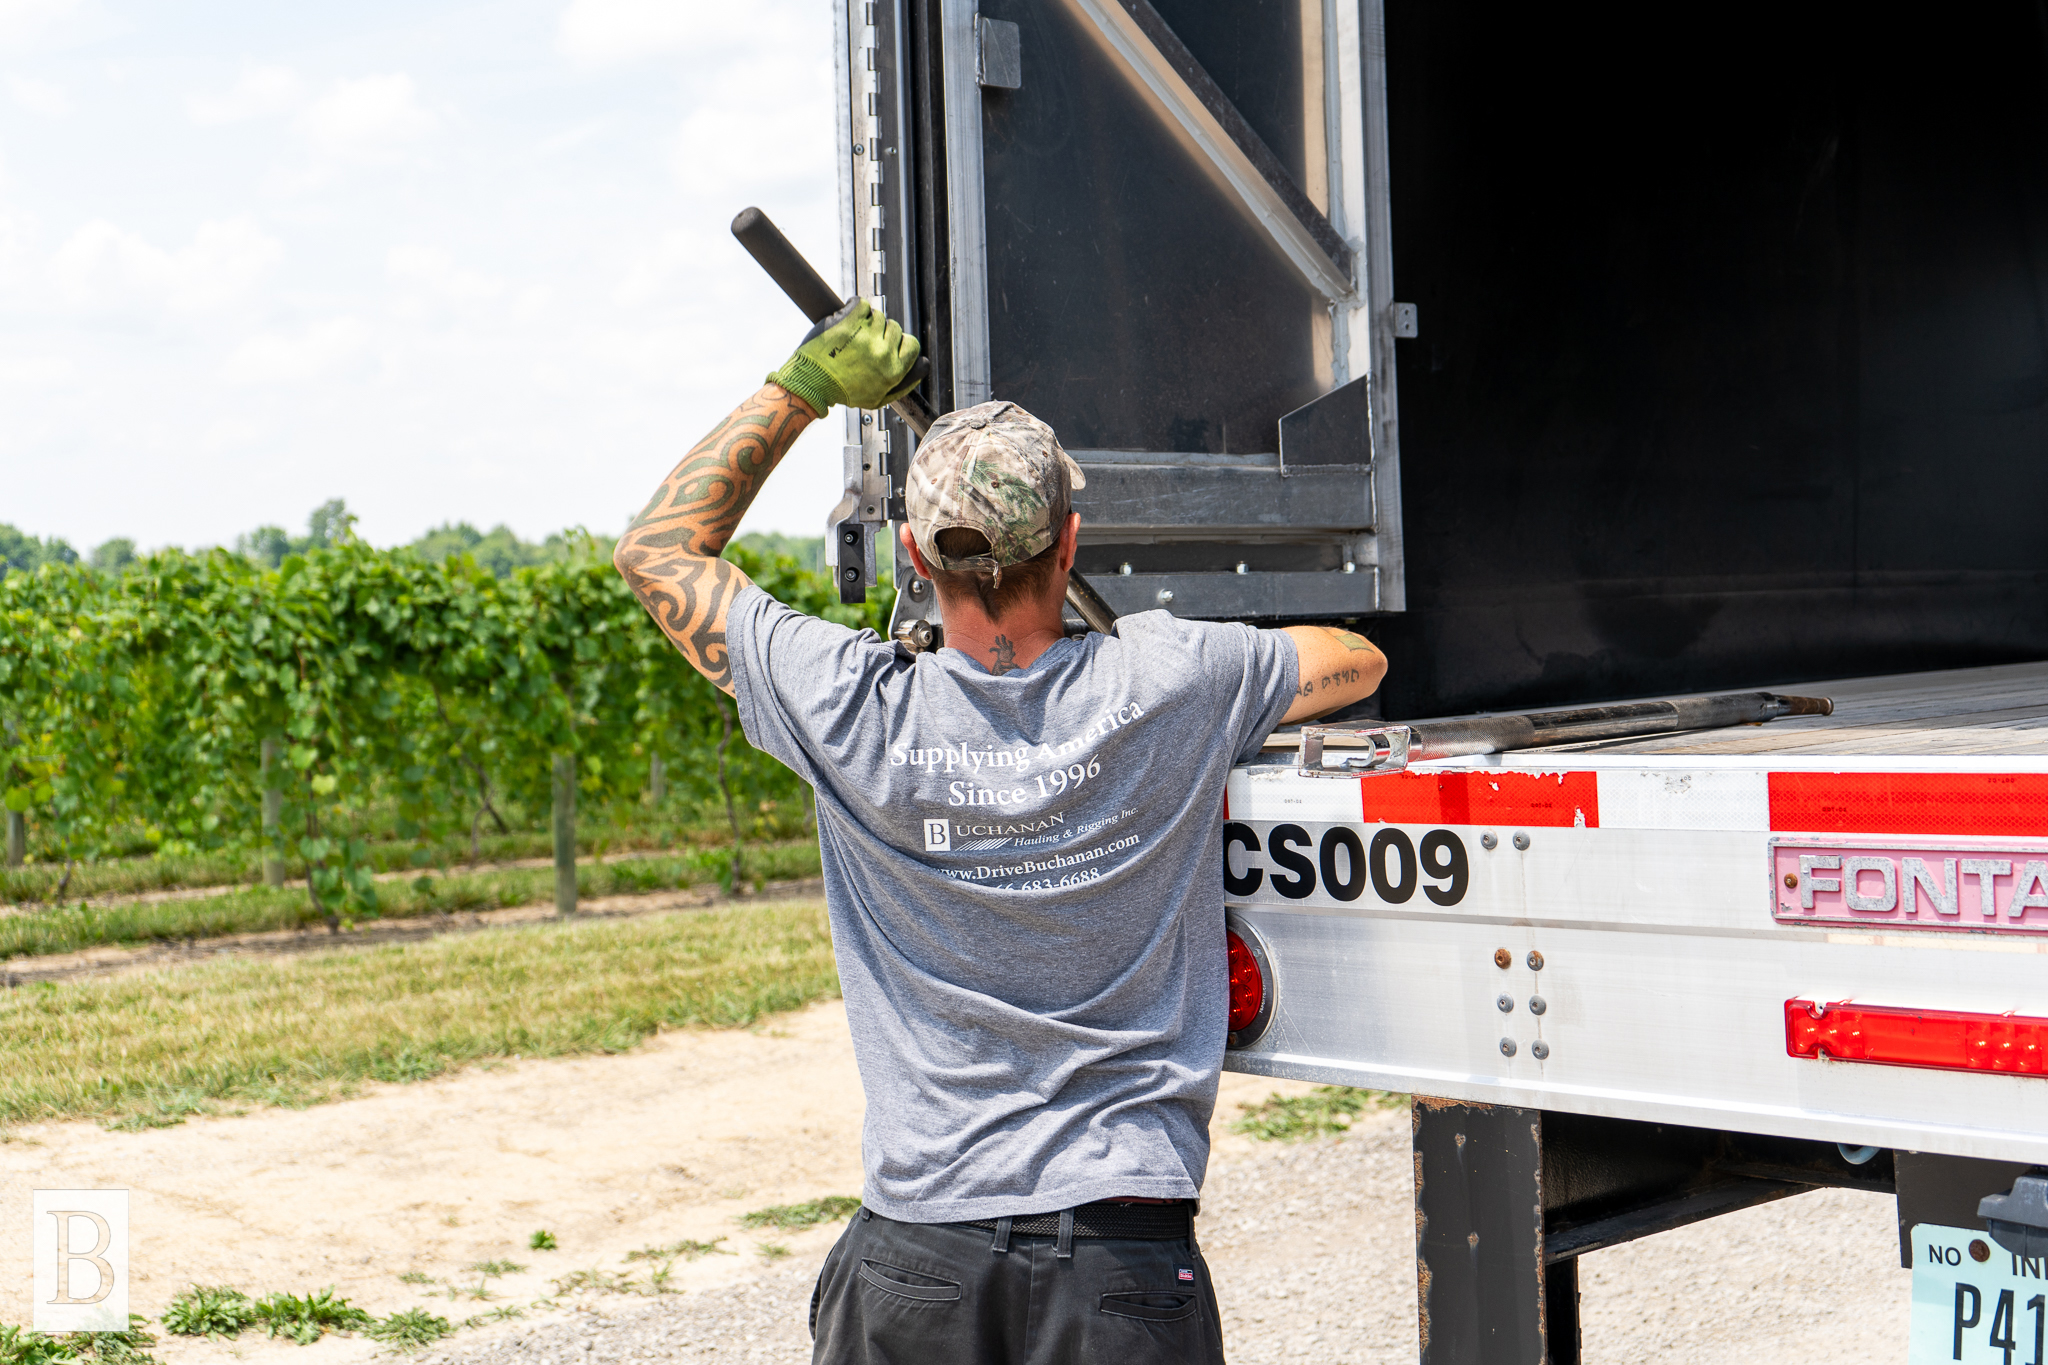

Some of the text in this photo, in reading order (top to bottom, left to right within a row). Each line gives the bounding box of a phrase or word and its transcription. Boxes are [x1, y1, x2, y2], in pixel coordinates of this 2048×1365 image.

[890, 700, 1145, 774] Supplying America
[949, 754, 1101, 806] Since 1996
[1014, 807, 1139, 847] Hauling & Rigging Inc.
[937, 833, 1141, 880] ww.DriveBuchanan.com
[1223, 822, 1470, 907] CS009
[1799, 854, 2048, 918] FONTA
[1928, 1244, 1962, 1267] NO
[1953, 1282, 2045, 1365] P41
